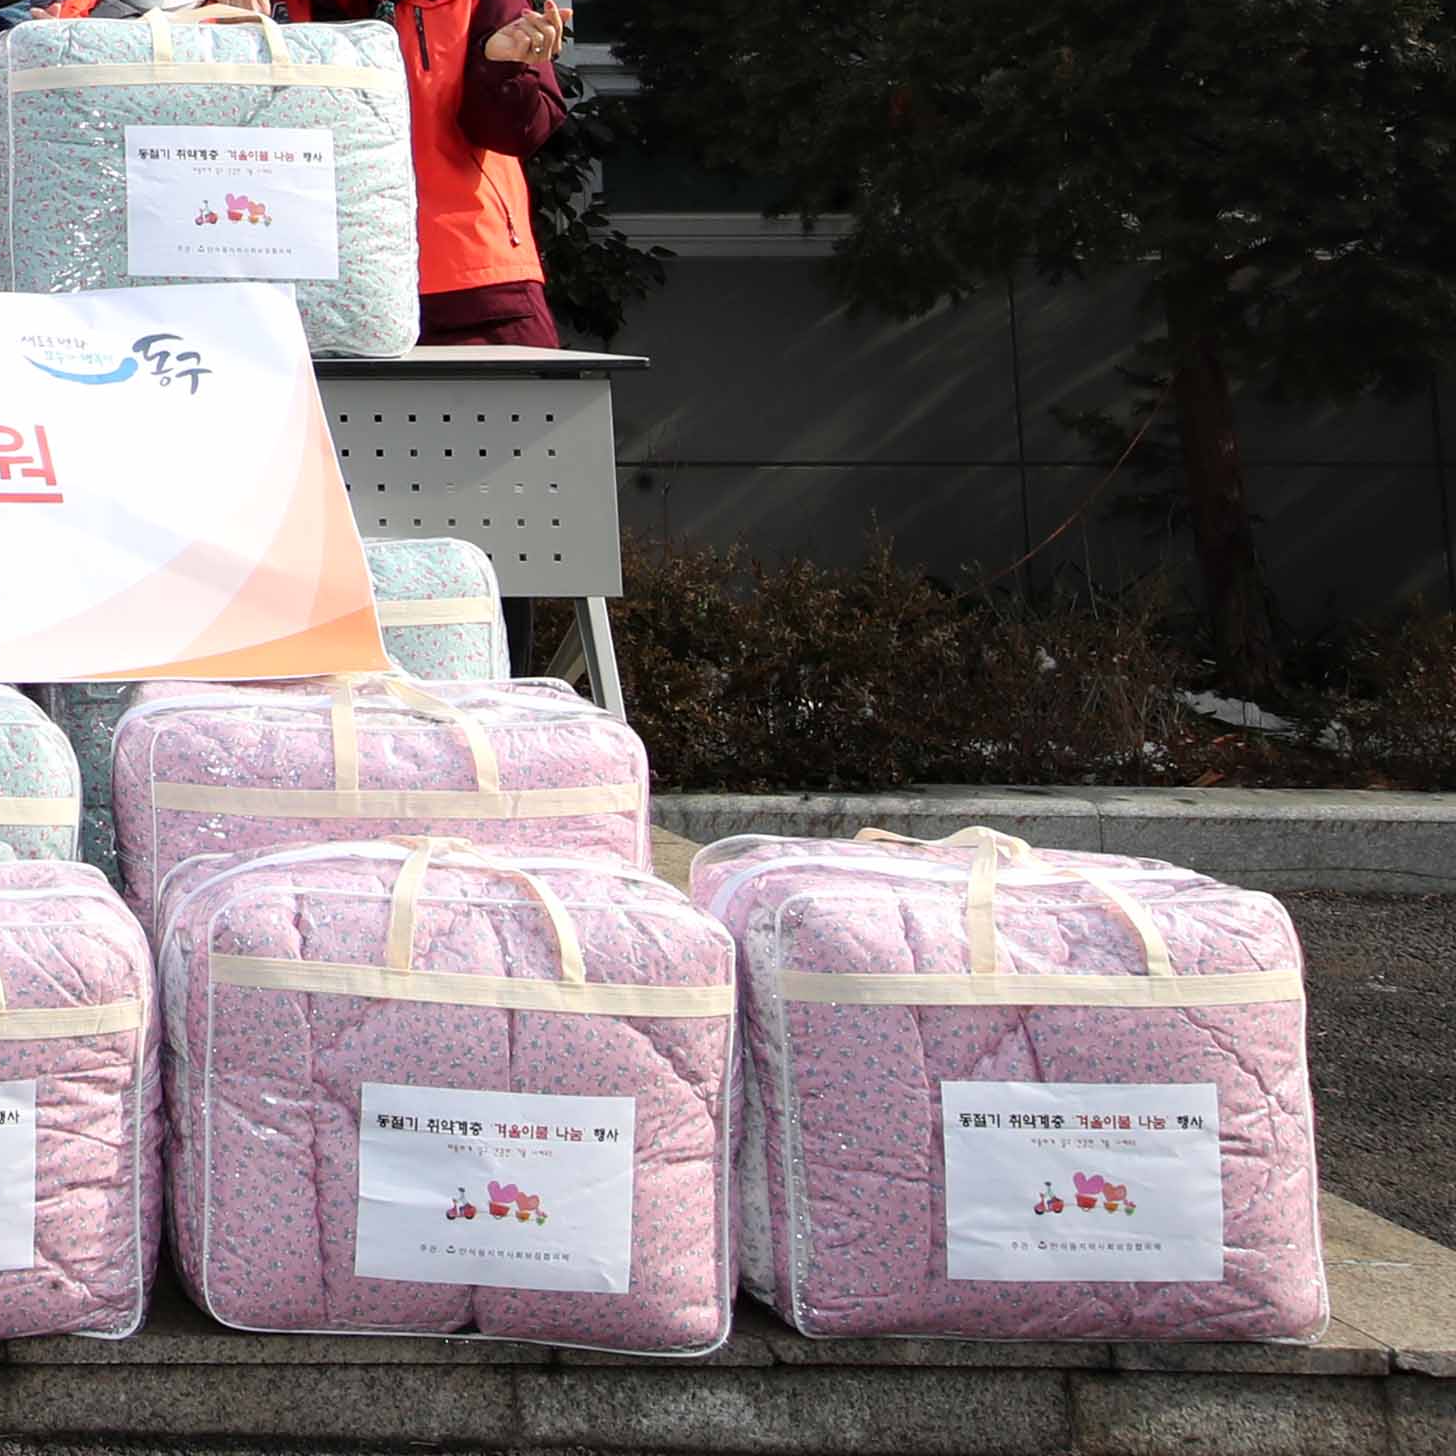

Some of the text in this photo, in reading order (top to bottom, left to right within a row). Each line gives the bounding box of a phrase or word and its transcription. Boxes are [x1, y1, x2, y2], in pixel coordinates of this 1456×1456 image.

[132, 333, 213, 395] 동구
[377, 1114, 418, 1131] 동절기
[427, 1118, 483, 1136] 취약계층
[594, 1128, 618, 1142] 행사
[959, 1113, 1000, 1128] 동절기
[1008, 1113, 1064, 1128] 취약계층
[1176, 1115, 1203, 1129] 행사
